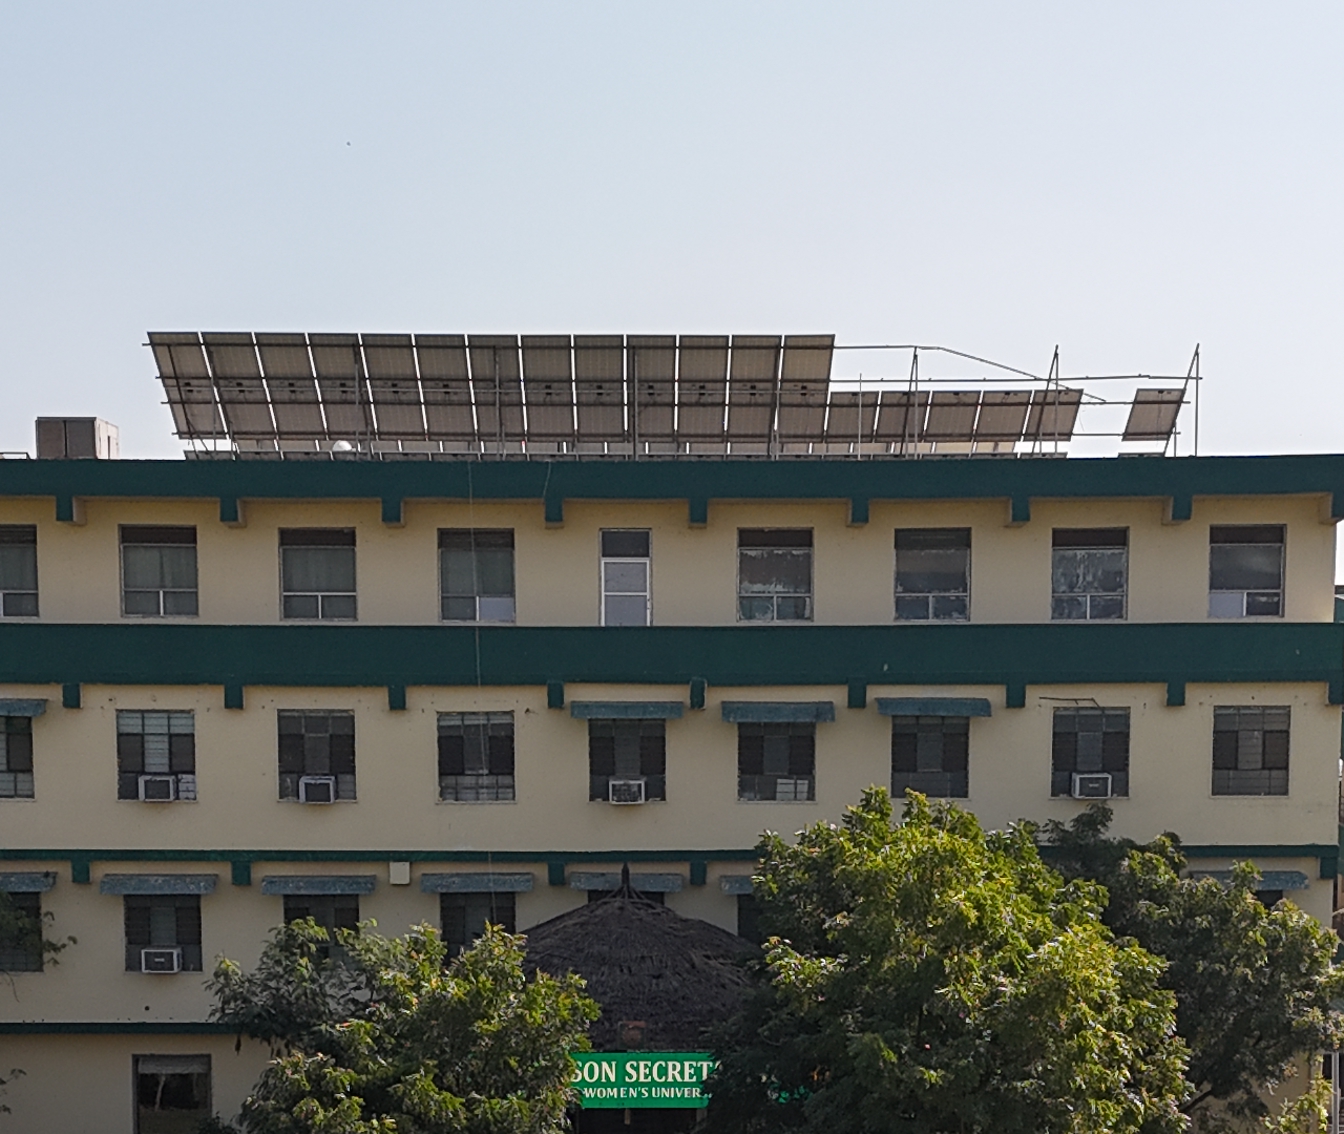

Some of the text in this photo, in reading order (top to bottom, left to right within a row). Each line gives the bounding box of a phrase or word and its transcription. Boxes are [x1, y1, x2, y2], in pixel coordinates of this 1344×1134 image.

[625, 1060, 721, 1082] SECRET
[584, 1087, 709, 1098] WOMEN'S UNIVER
